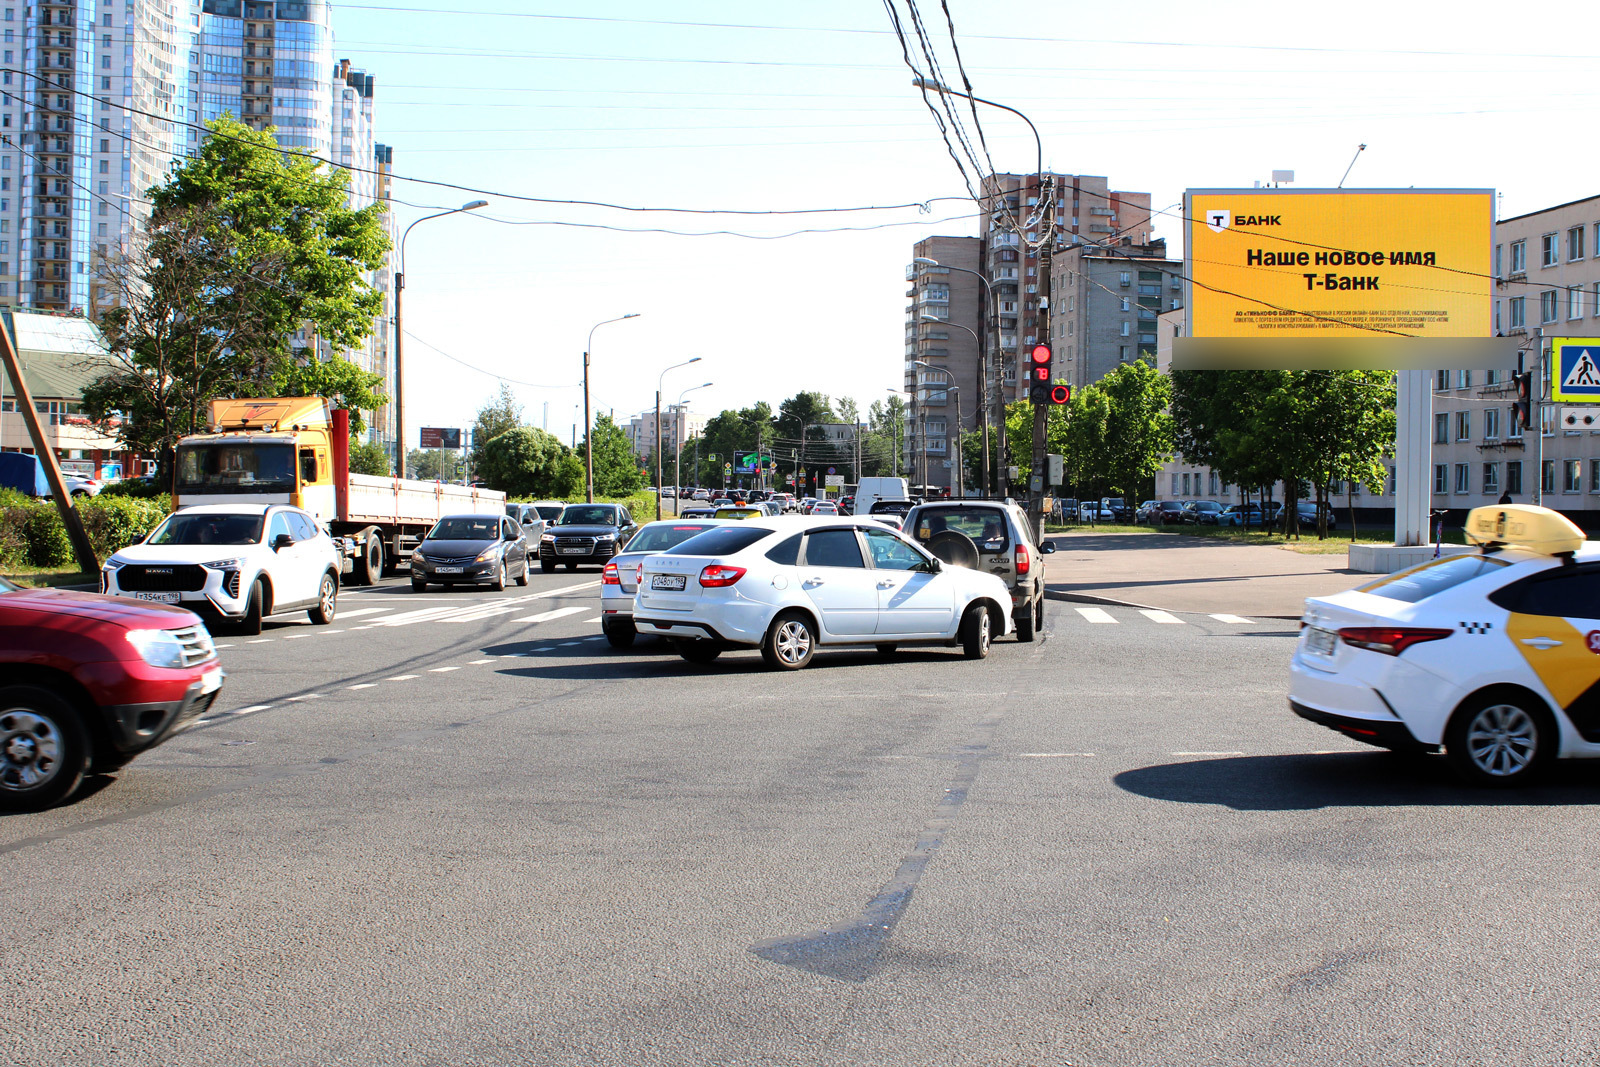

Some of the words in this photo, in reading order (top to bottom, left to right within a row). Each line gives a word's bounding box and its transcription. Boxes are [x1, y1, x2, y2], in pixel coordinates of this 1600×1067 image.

[1212, 215, 1224, 227] Т
[1234, 215, 1282, 226] БАНК
[1247, 248, 1310, 266] Наше
[1315, 250, 1384, 266] новое
[1390, 251, 1436, 266] имя
[1303, 273, 1380, 291] Т-Банк
